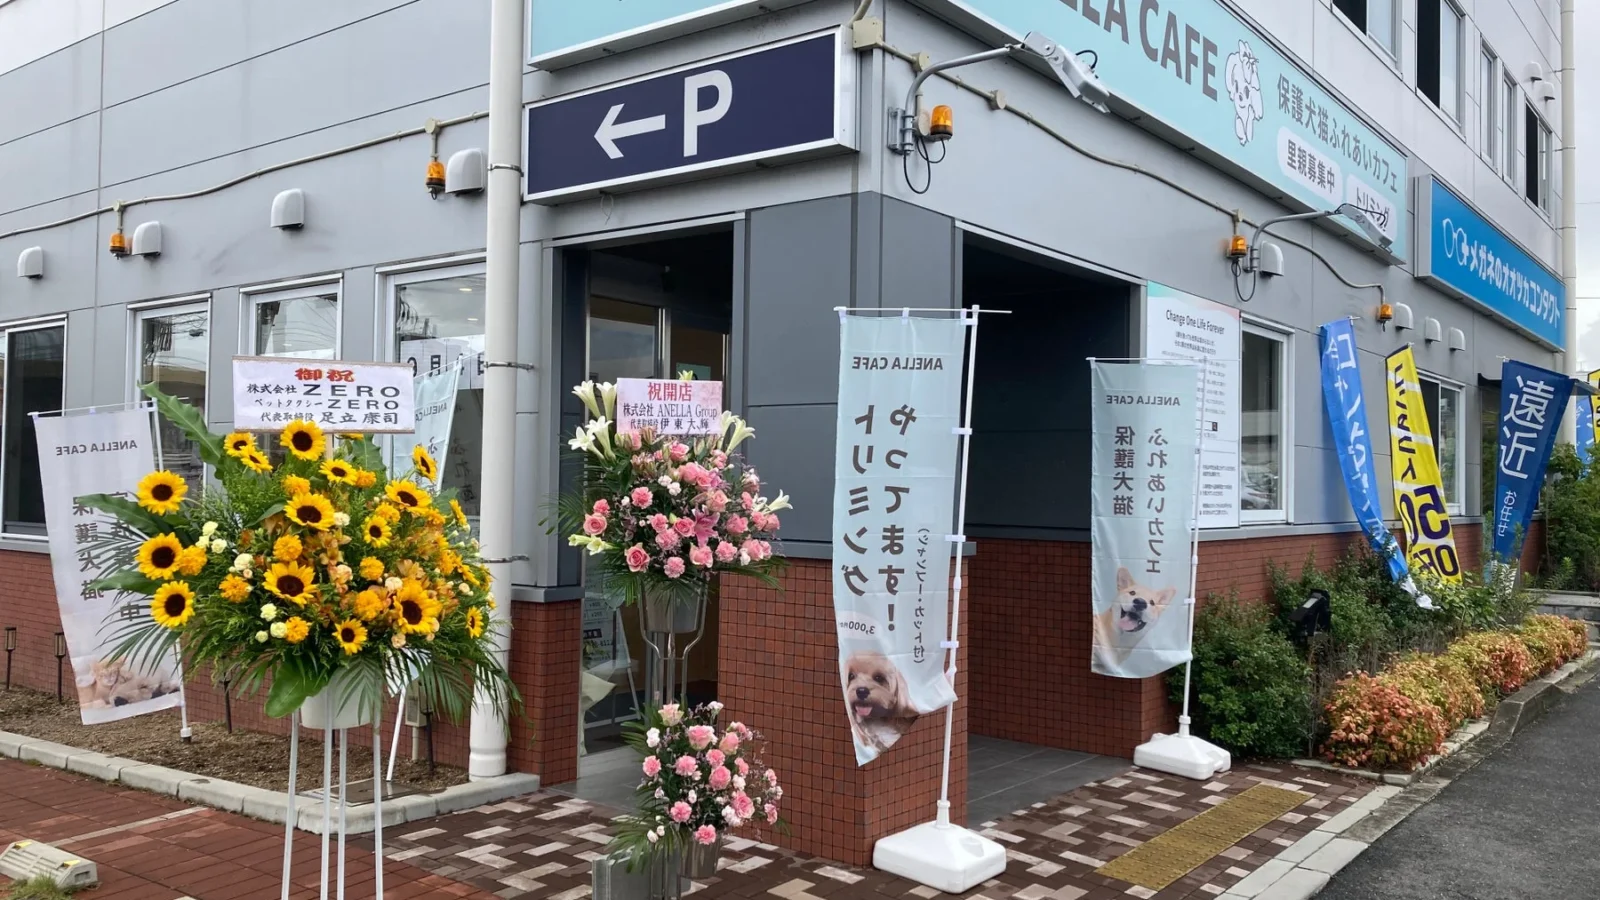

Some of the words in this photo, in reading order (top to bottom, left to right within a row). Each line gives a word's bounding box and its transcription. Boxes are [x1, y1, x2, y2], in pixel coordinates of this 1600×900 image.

[1140, 0, 1218, 102] CAFE
[683, 69, 733, 157] P
[1277, 73, 1398, 193] 保護犬猫ふれあいカフェ
[1287, 139, 1335, 194] 里親募集中
[1470, 240, 1560, 328] メガネのオオツカコンタクト
[1165, 309, 1186, 327] Change
[1186, 315, 1197, 328] One
[1196, 318, 1207, 331] Life
[1206, 321, 1225, 335] Forever
[294, 368, 356, 382] 御祝
[247, 384, 297, 395] 株式会社
[302, 384, 401, 398] ZERO
[648, 382, 692, 402] 祝開店
[327, 399, 400, 410] ZERO
[623, 402, 654, 417] 株式会社
[657, 403, 692, 418] ANELLA
[695, 404, 718, 420] Group
[260, 412, 315, 424] 代表取締役
[319, 411, 399, 425] 足立康司
[1500, 375, 1555, 480] 遠近
